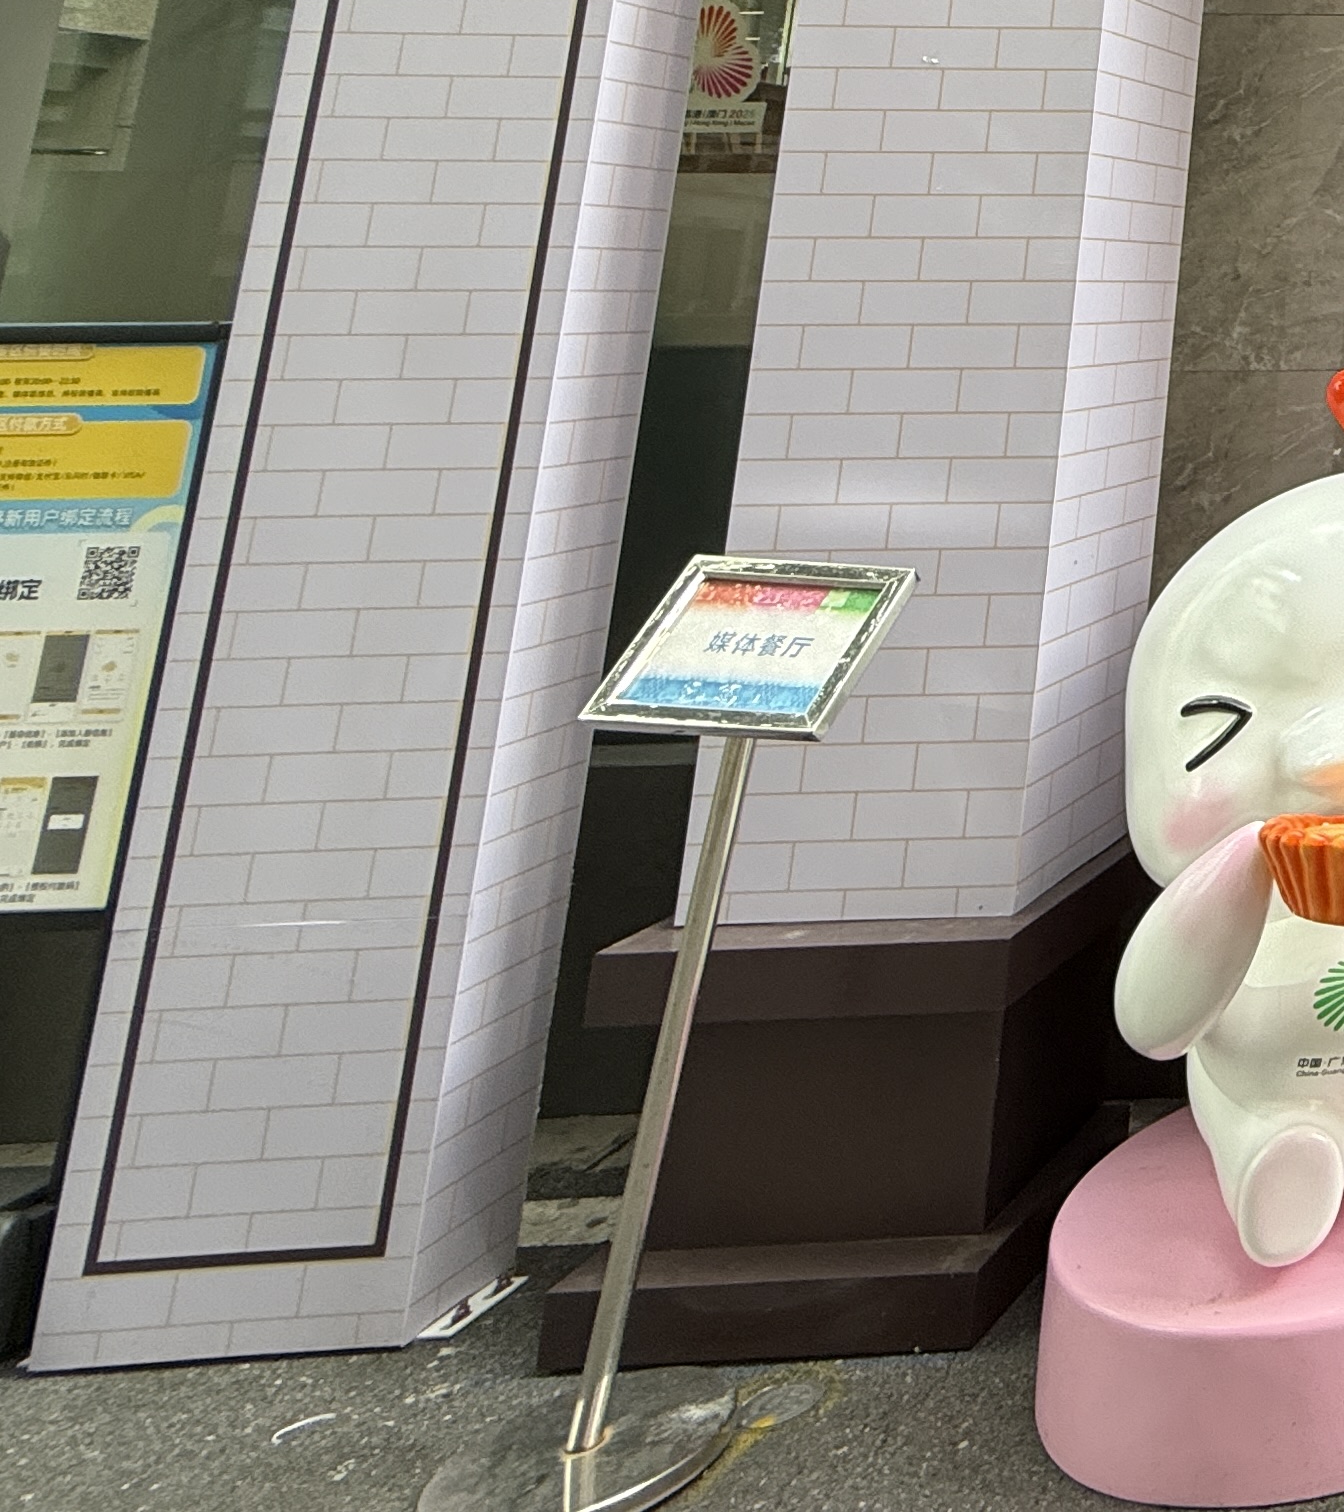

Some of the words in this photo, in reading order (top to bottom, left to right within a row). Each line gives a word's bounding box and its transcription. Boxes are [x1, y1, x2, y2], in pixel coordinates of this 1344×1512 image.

[0, 508, 133, 528] 新用户绑定流程
[703, 631, 815, 657] 媒体餐厅
